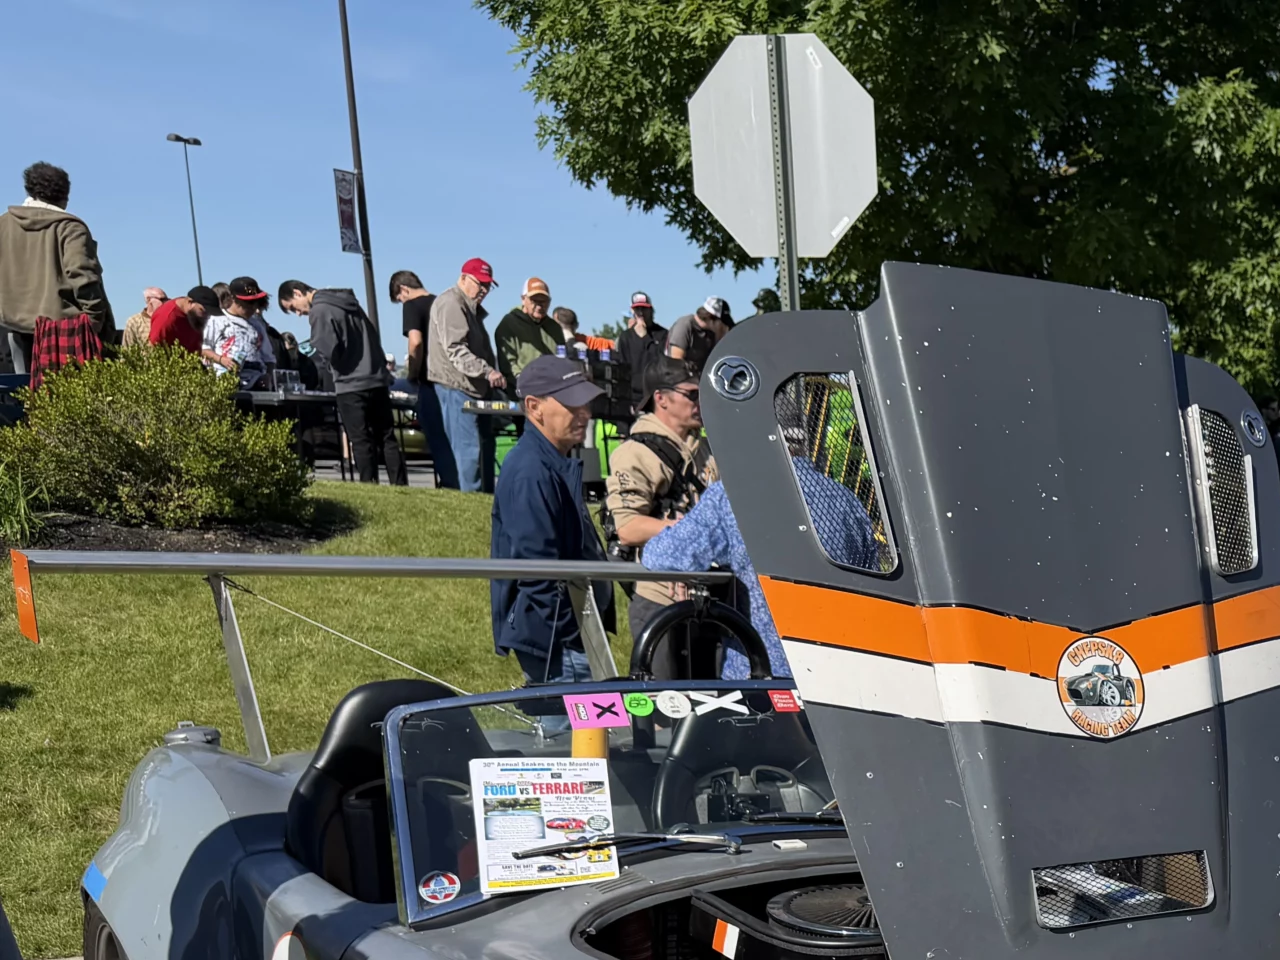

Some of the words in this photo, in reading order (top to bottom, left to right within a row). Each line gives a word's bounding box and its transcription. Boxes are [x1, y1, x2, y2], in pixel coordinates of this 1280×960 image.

[1067, 641, 1125, 667] CHEPSK8
[1072, 708, 1110, 736] RACING
[1109, 709, 1136, 735] TEAM
[484, 785, 517, 796] FORD
[532, 782, 585, 795] FERRARI
